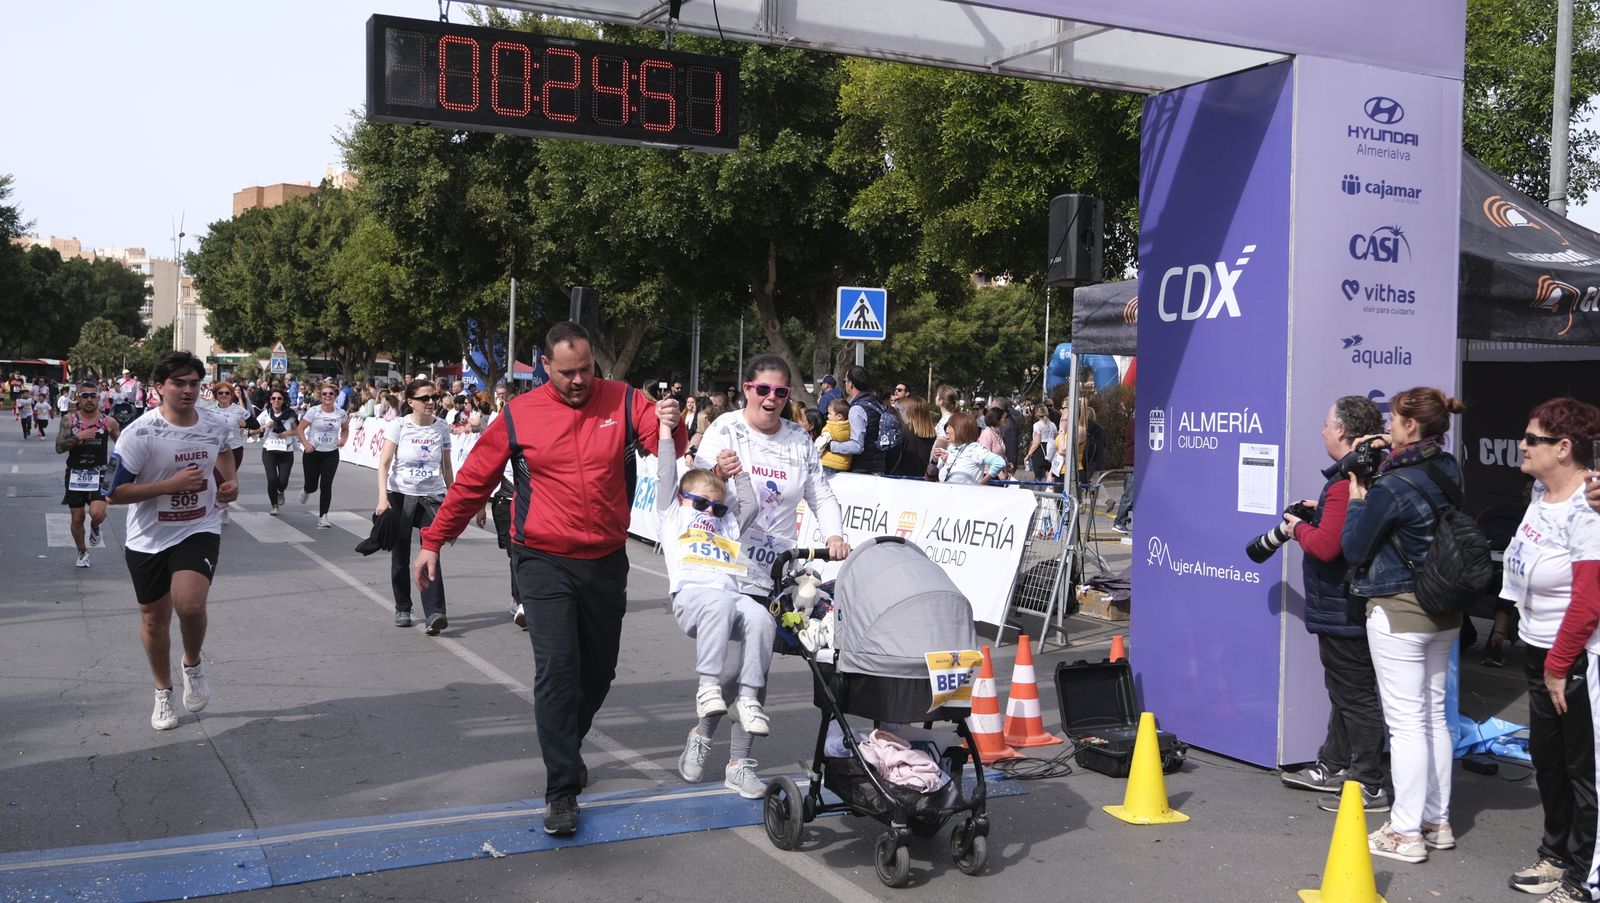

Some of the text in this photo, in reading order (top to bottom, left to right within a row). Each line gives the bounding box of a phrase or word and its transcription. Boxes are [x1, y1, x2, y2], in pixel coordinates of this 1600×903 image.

[438, 34, 723, 134] 00:24:51
[1347, 125, 1419, 147] HYUNDAI
[1356, 143, 1411, 161] Almerialva
[1364, 179, 1422, 200] cajamar
[1364, 283, 1416, 304] vithas
[1351, 346, 1412, 369] aqualia
[1178, 407, 1263, 434] ALMERÍA
[1178, 436, 1218, 450] CIUDAD
[175, 451, 208, 462] MUJER
[409, 469, 434, 478] 1203
[751, 465, 787, 480] MUJER
[171, 493, 199, 506] 509
[839, 503, 889, 534] MERÍA
[926, 516, 1015, 550] ALMERÍA
[689, 542, 731, 563] 1519
[925, 546, 967, 567] CIUDAD
